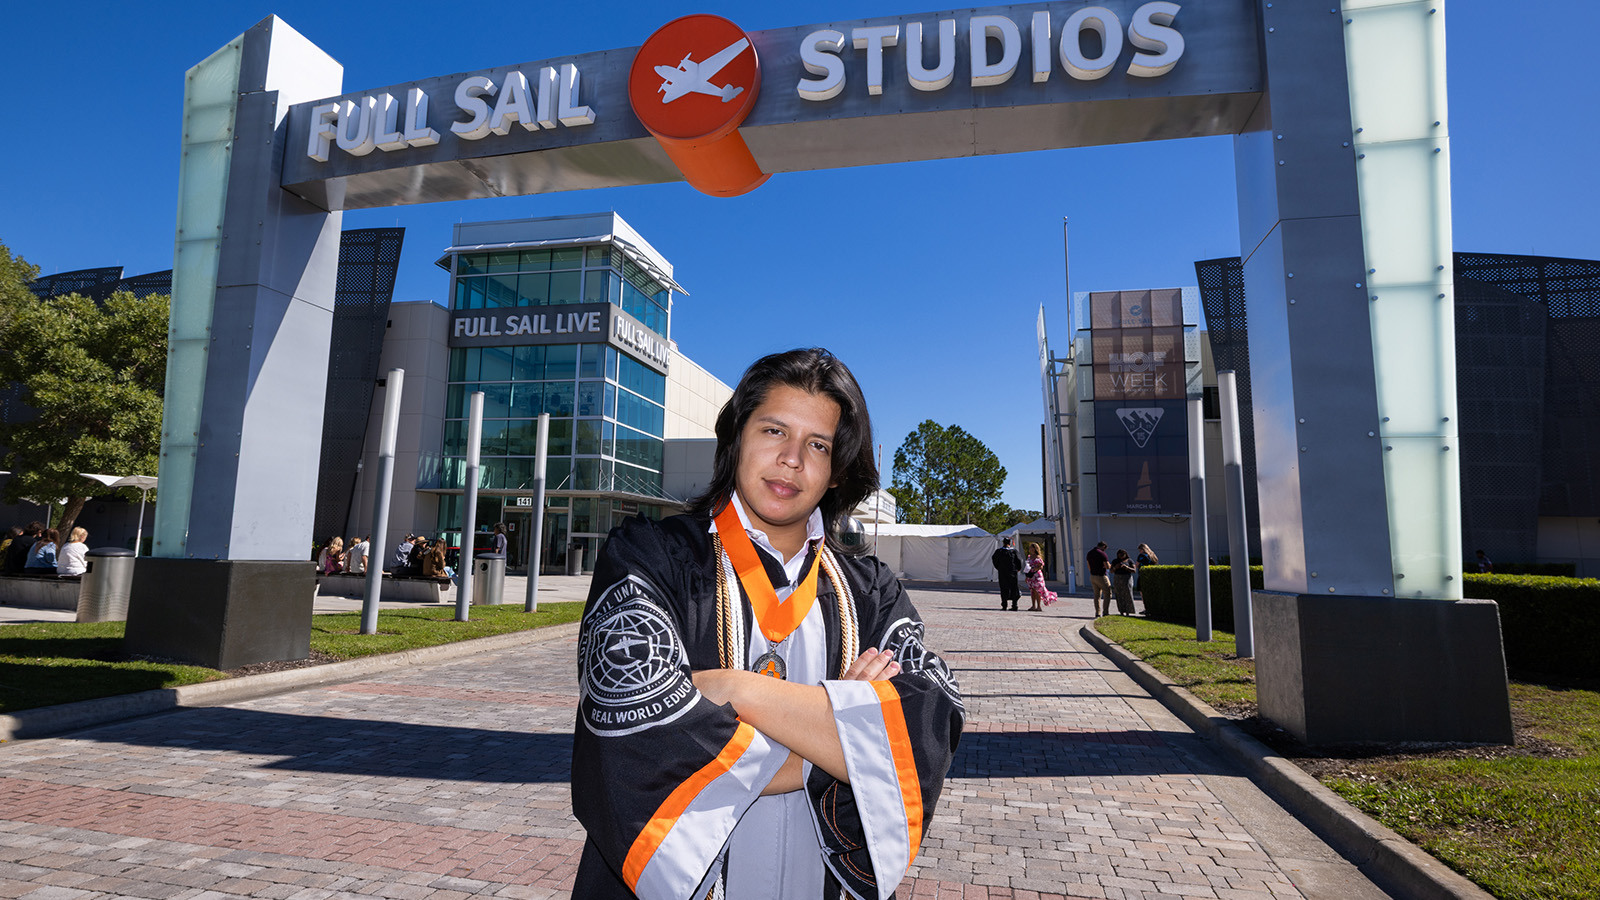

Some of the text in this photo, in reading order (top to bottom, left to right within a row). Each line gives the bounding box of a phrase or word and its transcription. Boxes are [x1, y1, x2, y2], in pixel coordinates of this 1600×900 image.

[307, 1, 1185, 162] FULL SAIL STUDIOS
[454, 311, 600, 338] FULL SAIL LIVE
[614, 315, 670, 366] FULL SAIL LIVE
[1109, 351, 1167, 372] HOF
[1110, 372, 1168, 387] WEEK
[518, 498, 531, 506] 141
[591, 708, 613, 724] REAL
[615, 701, 663, 724] WORLD
